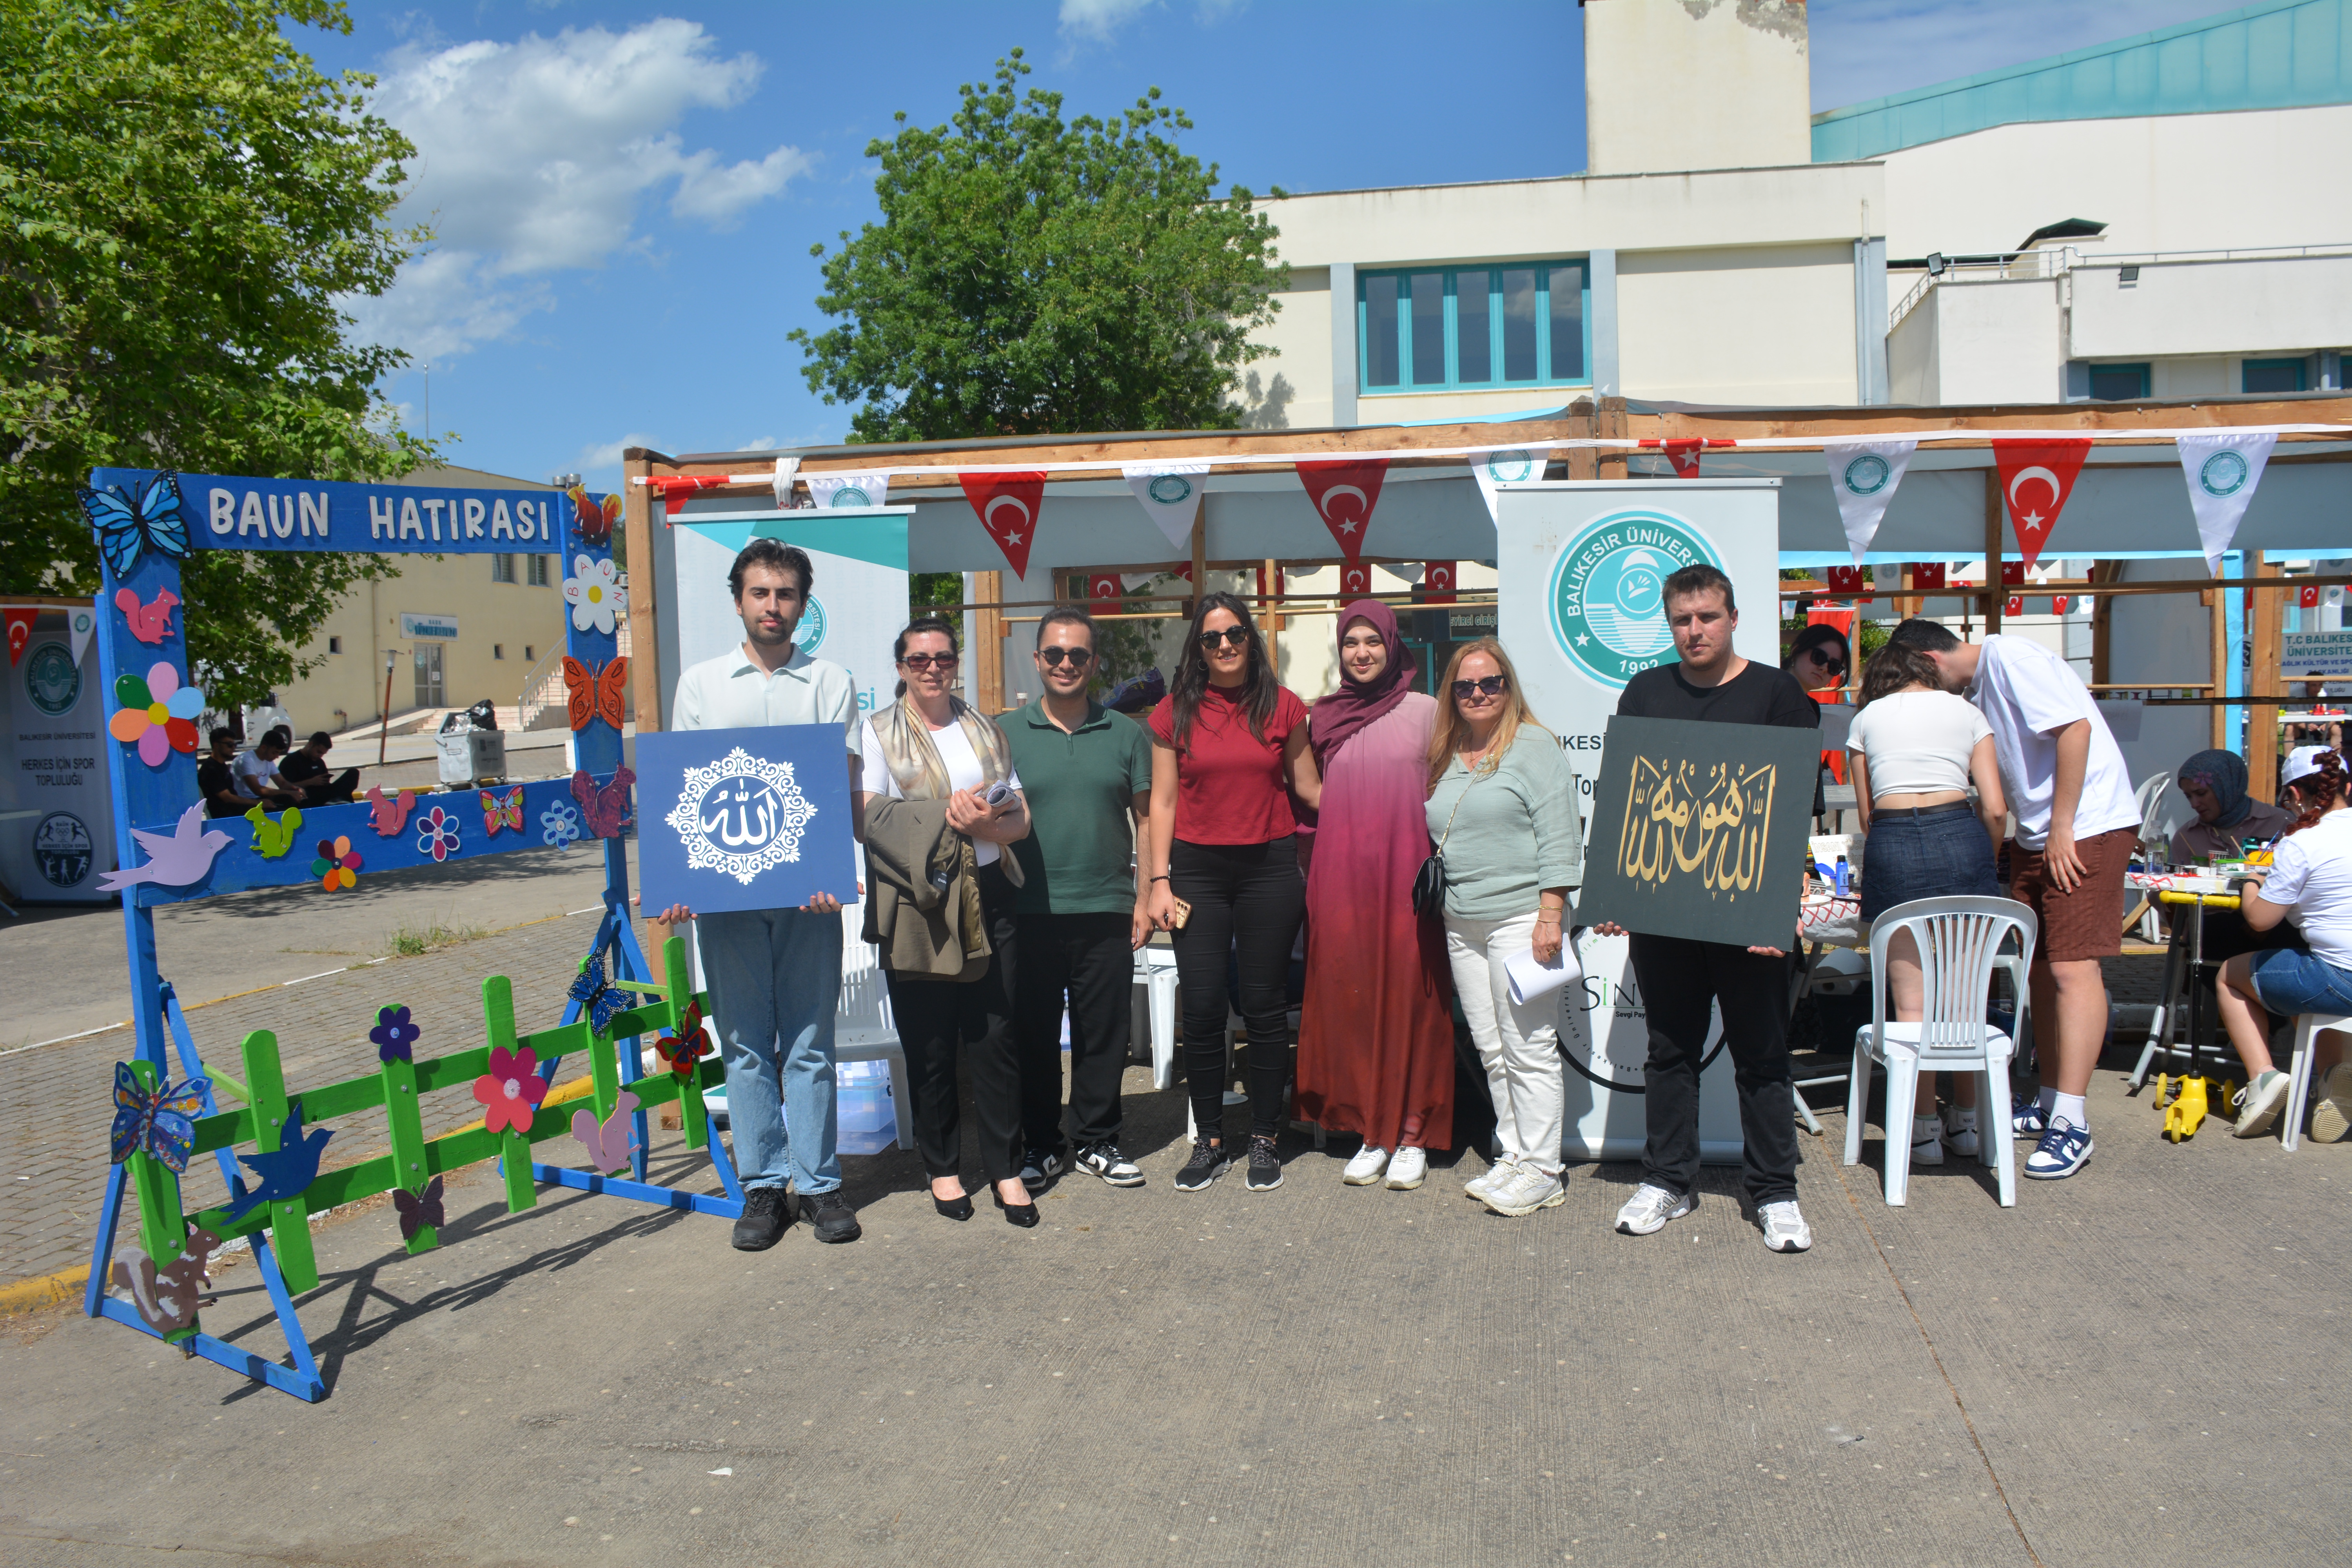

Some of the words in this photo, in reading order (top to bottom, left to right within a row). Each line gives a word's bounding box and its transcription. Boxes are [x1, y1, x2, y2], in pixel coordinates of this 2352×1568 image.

[209, 488, 328, 538] BAUN
[369, 495, 549, 541] HATIRASI
[1566, 531, 1622, 617] BALIKESİR
[1626, 526, 1699, 568] ÜNİVERS
[806, 601, 821, 630] ERSİTESİ
[1450, 614, 1474, 626] EYİRCİ
[1475, 613, 1498, 628] GİRİŞİ
[1619, 659, 1659, 675] 1992
[19, 733, 52, 741] BALIKESİR
[53, 731, 96, 740] ÜNİVERSİTESİ
[1557, 732, 1606, 750] IKESİ
[22, 759, 54, 770] HERKES
[56, 756, 71, 772] İÇİN
[73, 758, 95, 769] SPOR
[35, 772, 83, 786] TOPLULUĞU
